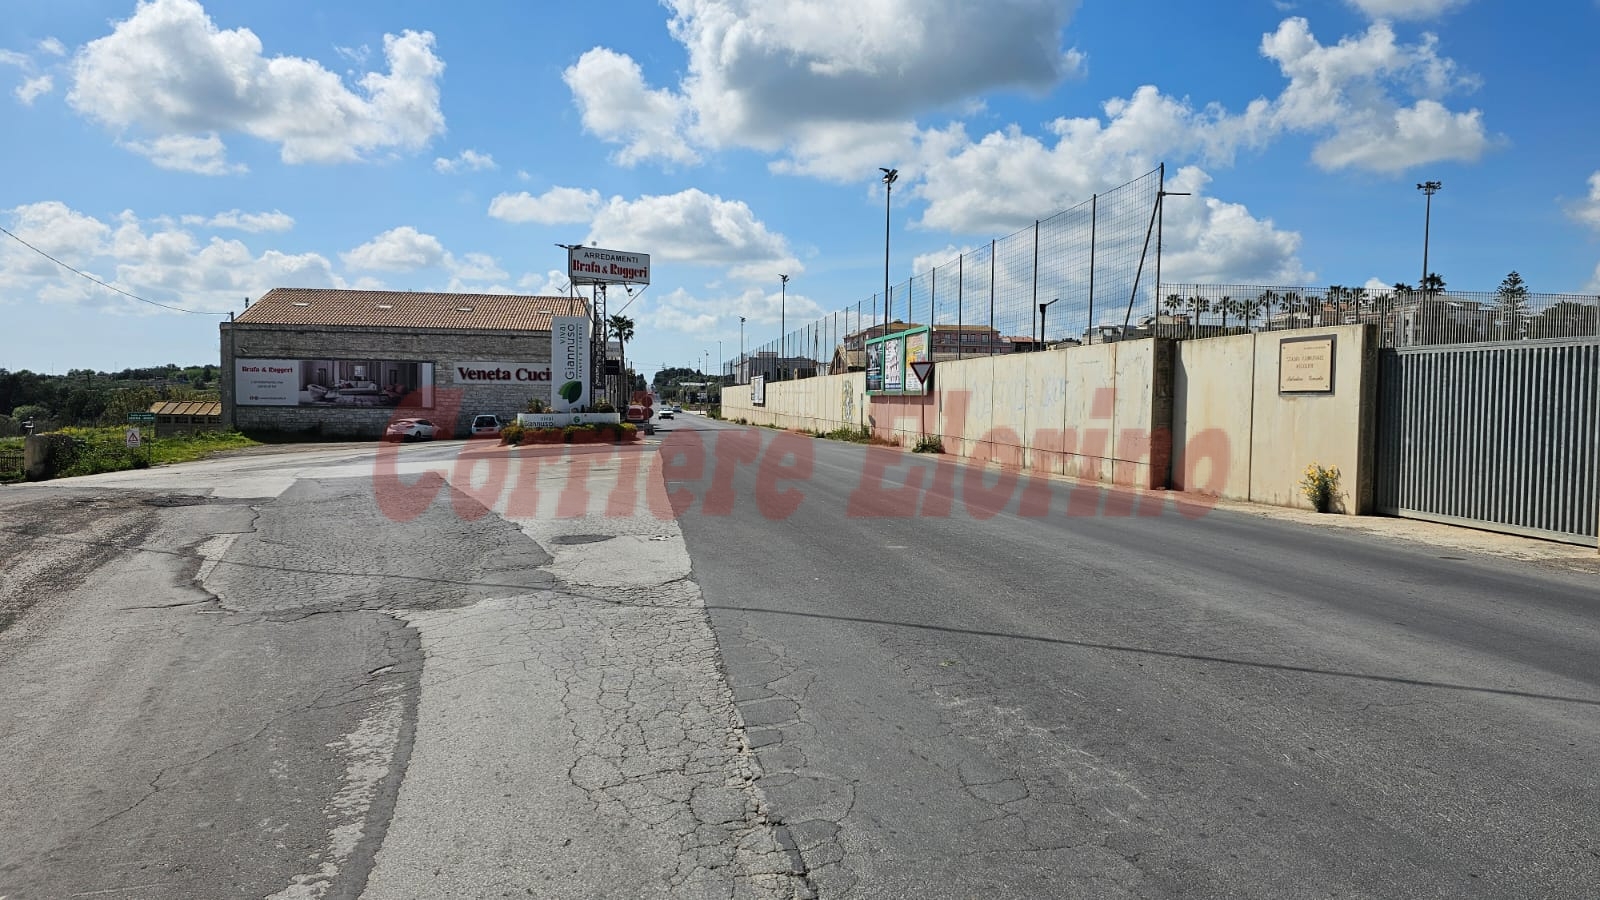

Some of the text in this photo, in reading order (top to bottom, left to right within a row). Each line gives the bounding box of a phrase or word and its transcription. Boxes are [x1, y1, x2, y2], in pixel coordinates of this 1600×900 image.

[584, 252, 638, 263] ARREDAMENTI
[573, 259, 647, 279] Brafa & Ruggeri
[565, 324, 575, 380] Giannuso
[458, 367, 552, 381] Veneta Cuci
